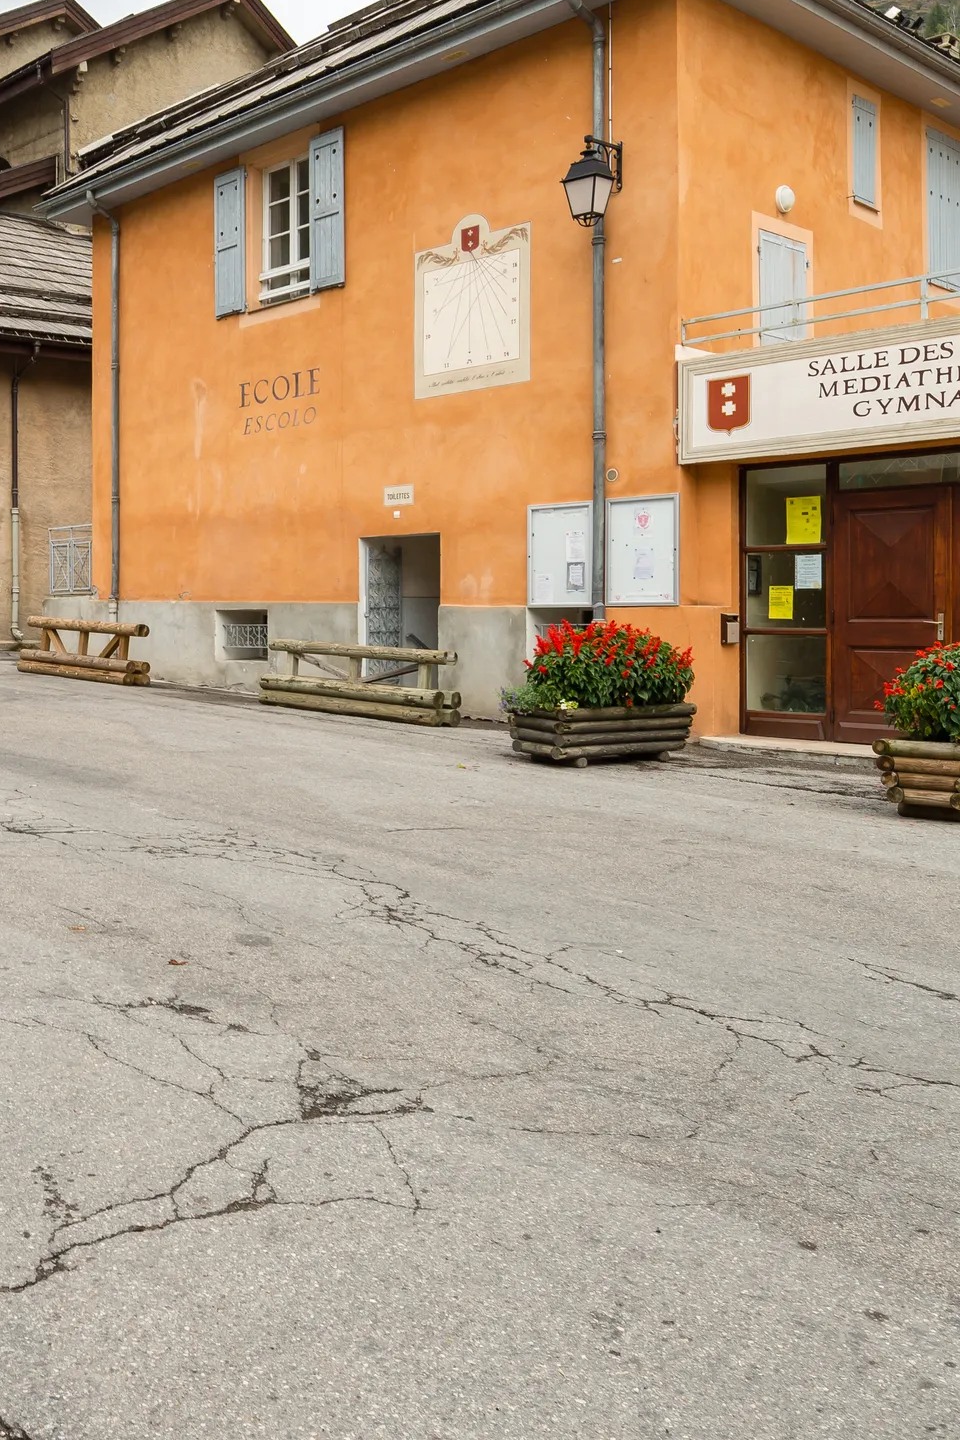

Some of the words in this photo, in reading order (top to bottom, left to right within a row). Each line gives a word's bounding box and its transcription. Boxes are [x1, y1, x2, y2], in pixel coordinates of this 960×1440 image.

[807, 350, 889, 377] SALLE
[897, 341, 954, 366] DES
[239, 367, 320, 408] ECOLE
[243, 406, 317, 435] ESCOLO
[387, 492, 410, 500] TOILETTES
